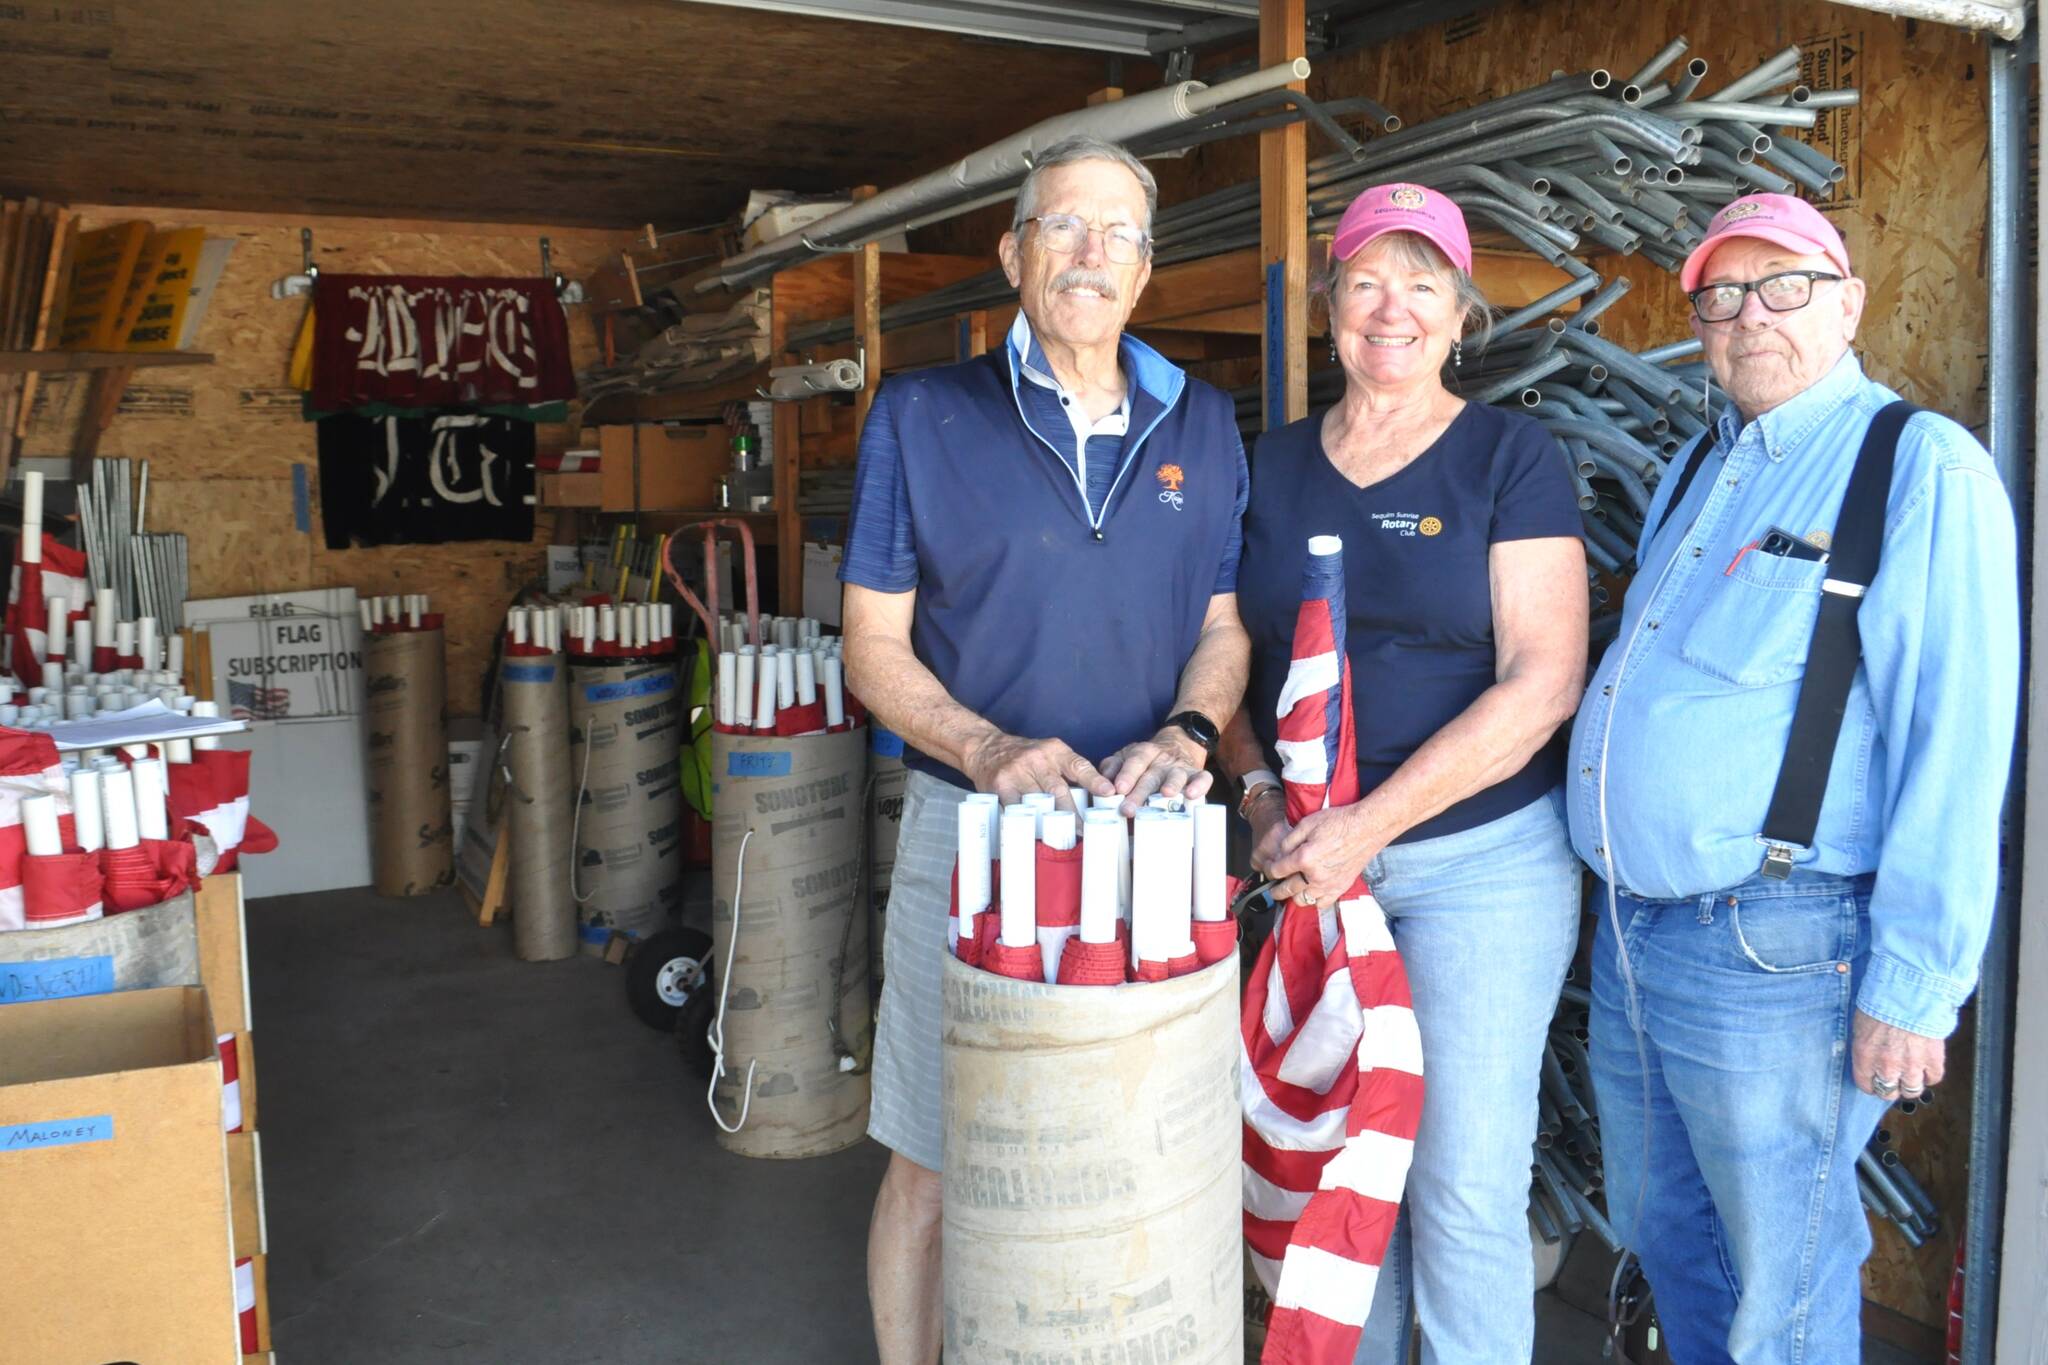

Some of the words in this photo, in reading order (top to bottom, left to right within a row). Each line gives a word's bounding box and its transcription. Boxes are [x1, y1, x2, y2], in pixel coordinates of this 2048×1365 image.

[1371, 511, 1395, 520] Sequim
[1396, 511, 1419, 519] Sunrise
[1381, 520, 1418, 530] Rotary
[277, 624, 322, 644] FLAG
[228, 651, 363, 677] SUBSCRIPTION
[8, 1125, 96, 1145] MALONEY
